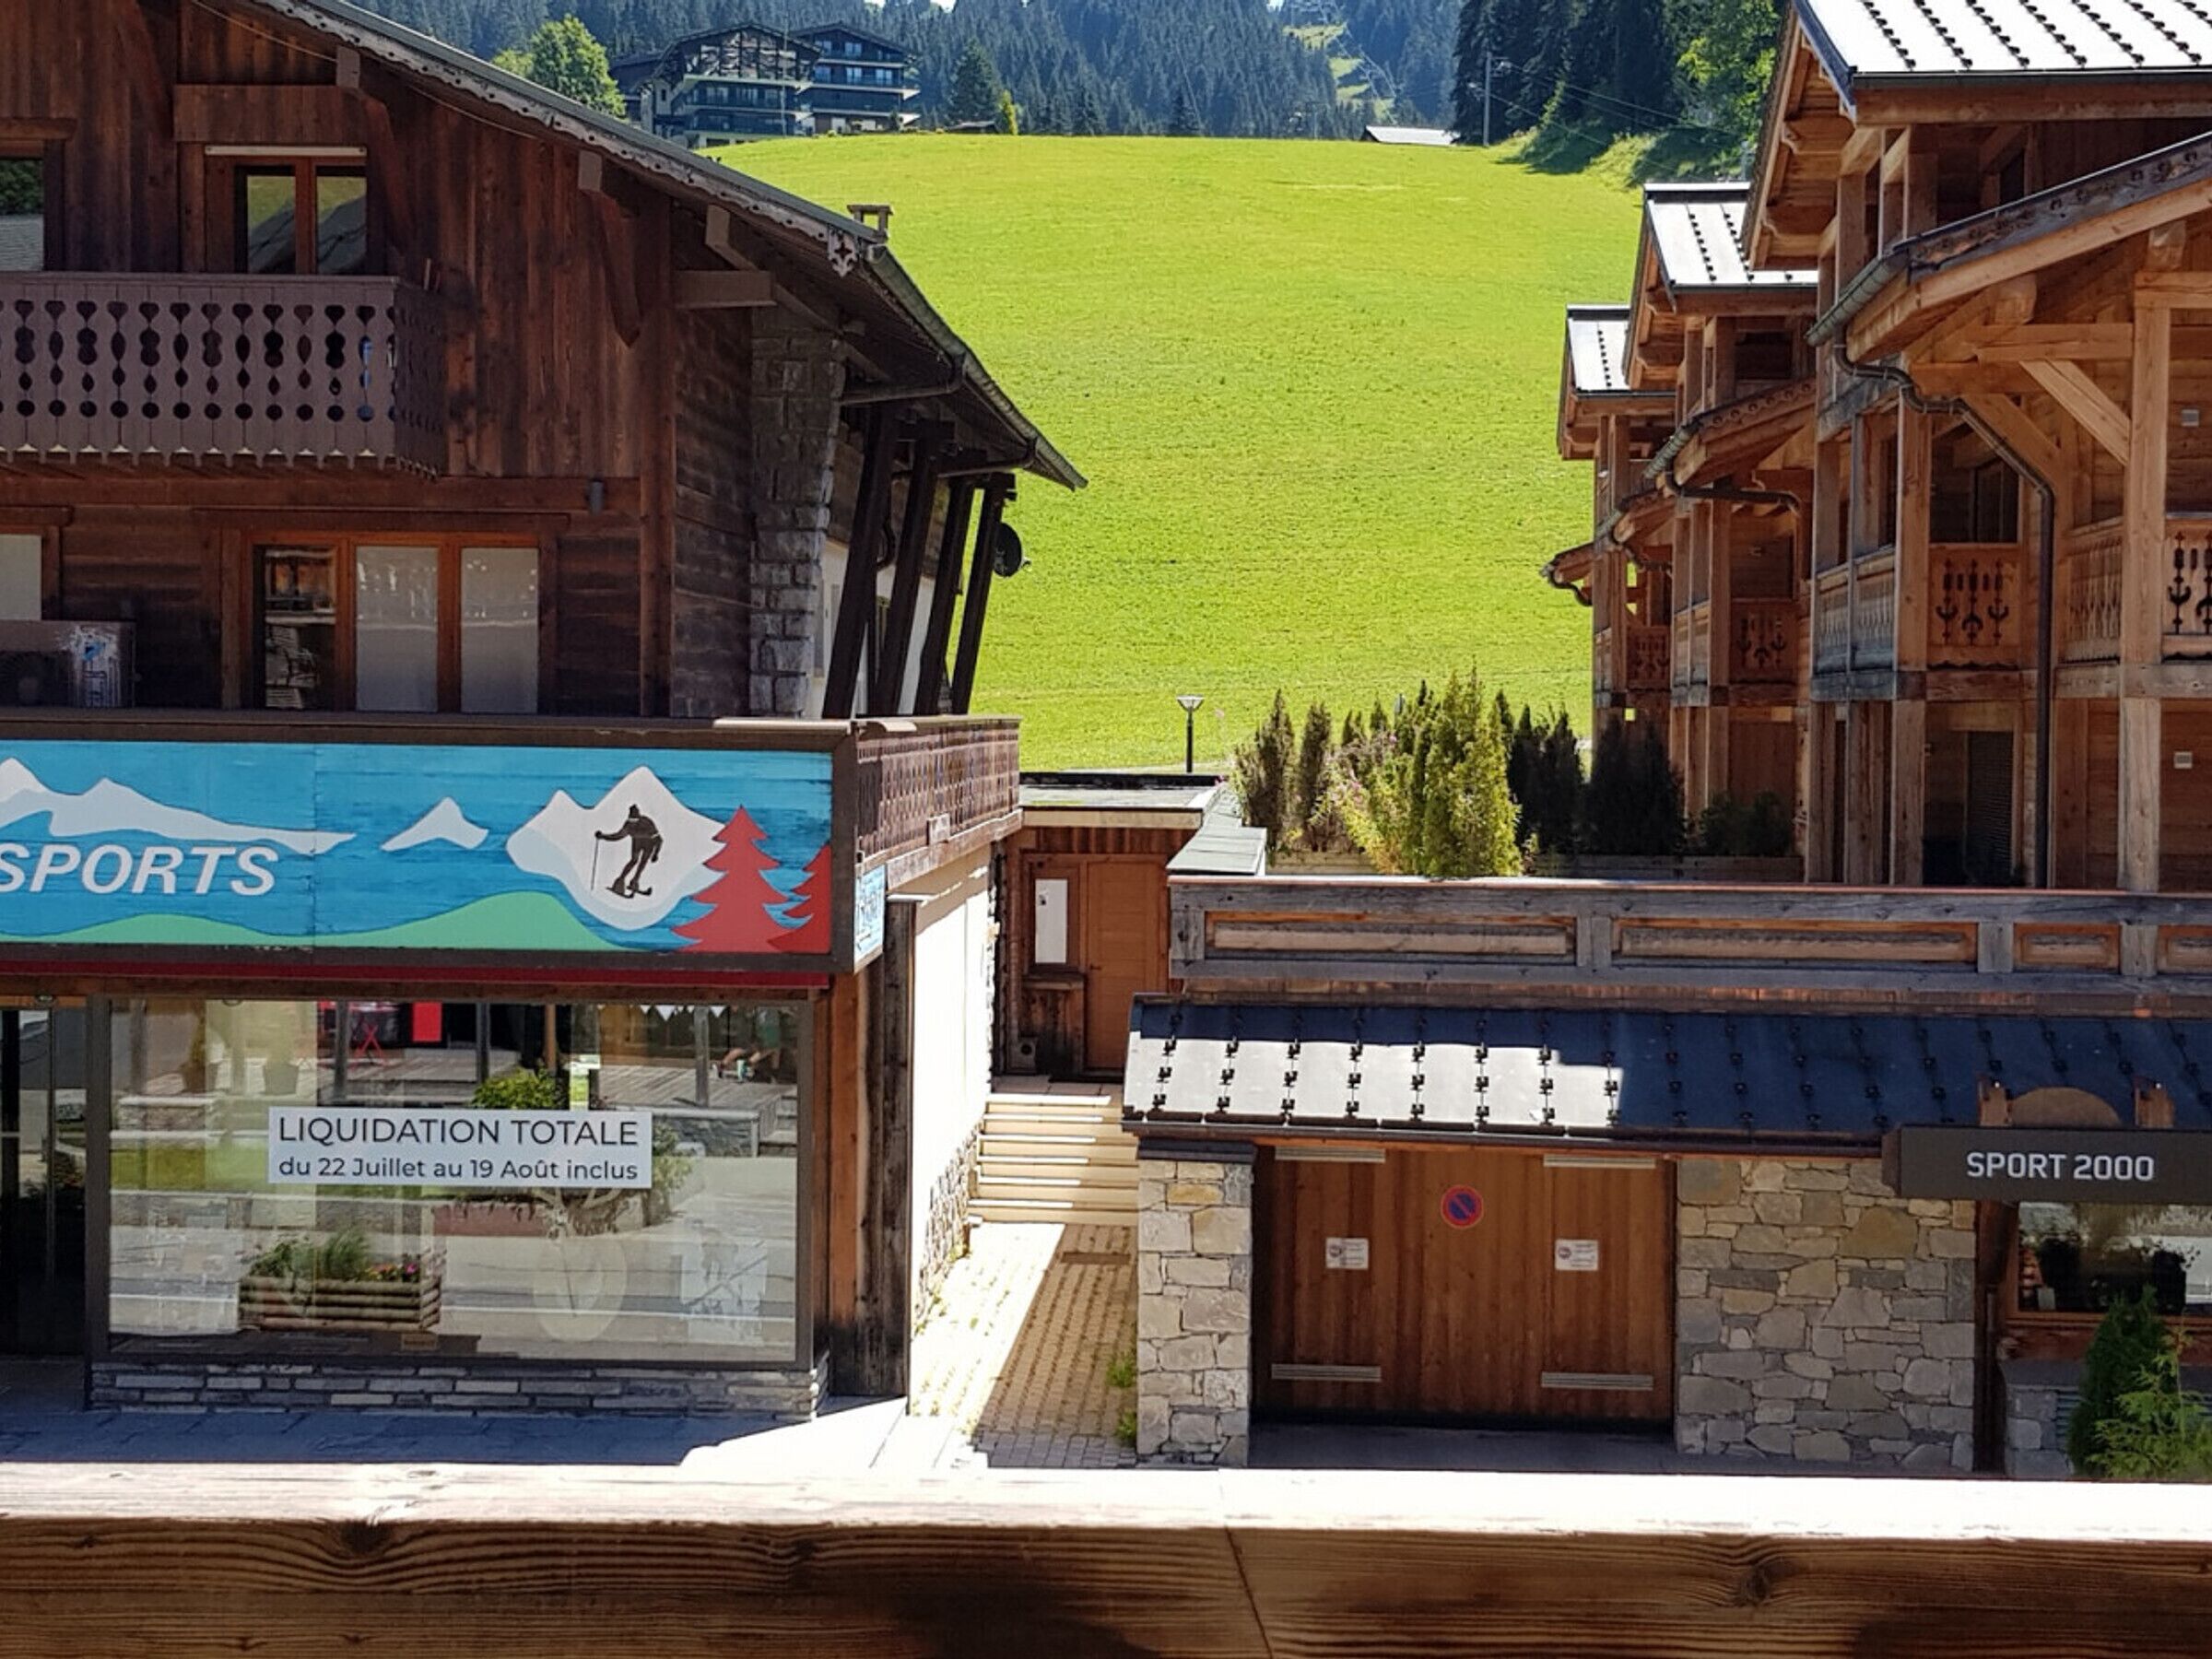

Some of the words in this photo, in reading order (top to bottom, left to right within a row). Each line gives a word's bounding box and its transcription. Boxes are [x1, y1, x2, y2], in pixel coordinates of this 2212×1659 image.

[279, 1117, 500, 1147] LIQUIDATION
[512, 1120, 639, 1146] TOTALE
[278, 1157, 311, 1177] du
[318, 1158, 346, 1177] 22
[352, 1157, 426, 1178] Juillet
[433, 1162, 462, 1178] au
[471, 1159, 493, 1178] 19
[500, 1158, 559, 1180] Août
[567, 1159, 639, 1181] inclus
[1966, 1152, 2067, 1179] SPORT
[2074, 1155, 2155, 1182] 2000
